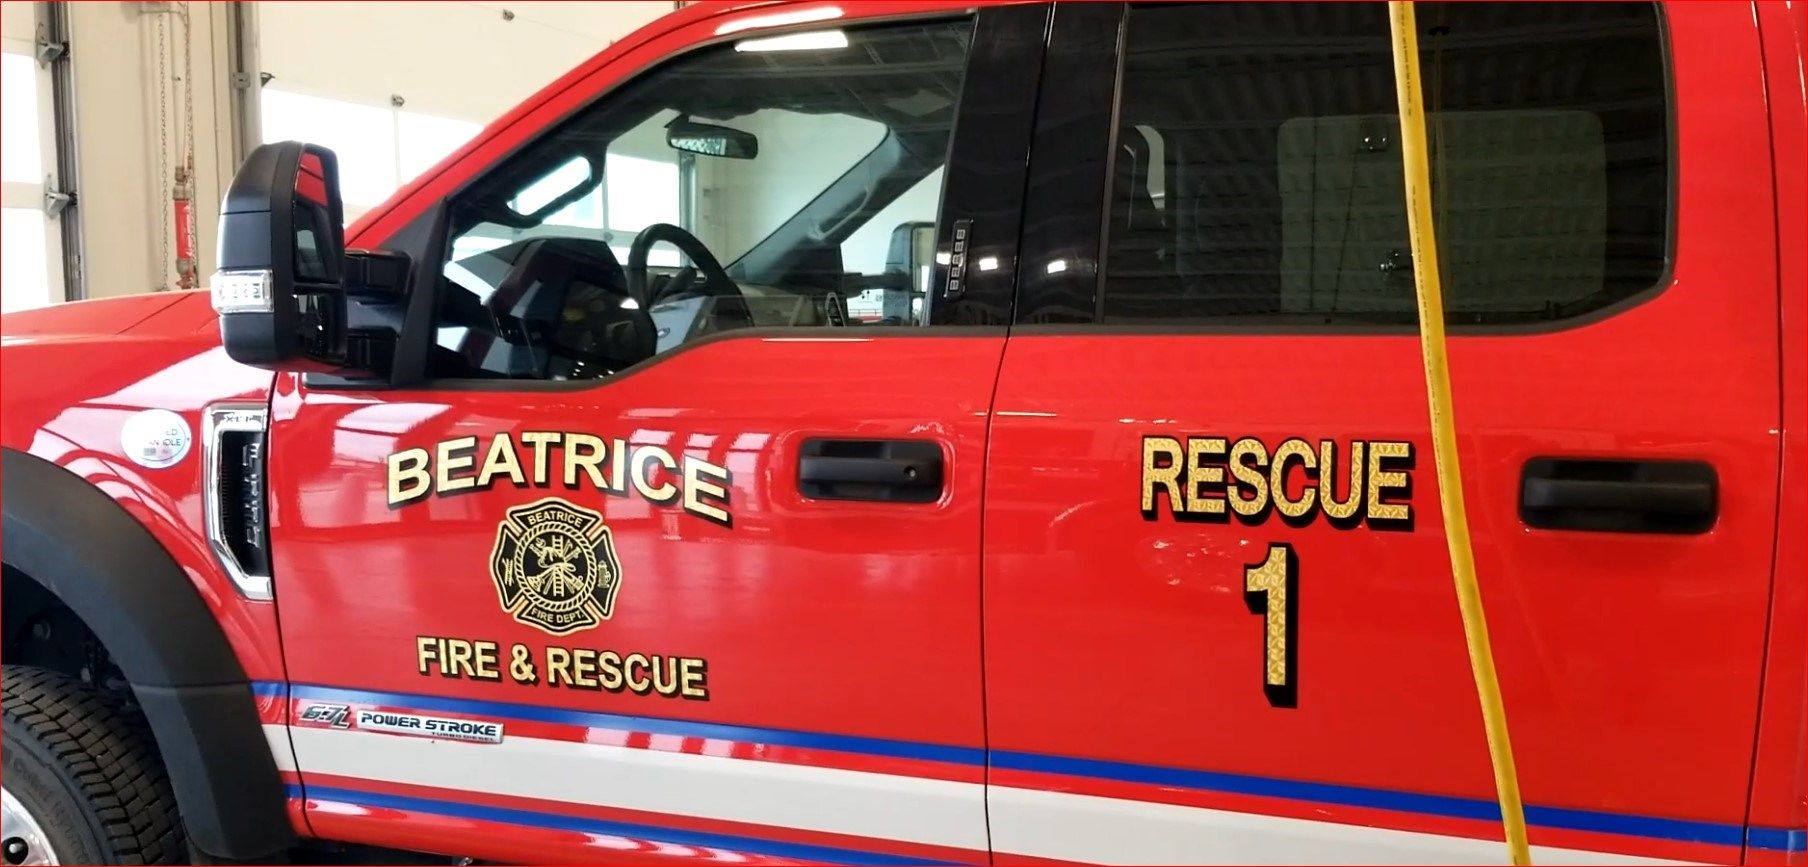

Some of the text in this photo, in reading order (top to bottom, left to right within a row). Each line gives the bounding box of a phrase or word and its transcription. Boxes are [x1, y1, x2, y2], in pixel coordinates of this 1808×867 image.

[387, 432, 731, 526] BEATRICE
[1141, 436, 1413, 527] RESCUE
[527, 510, 583, 528] BEATRICE
[530, 608, 585, 623] FIRE DEPT.
[1244, 543, 1294, 702] 1
[416, 636, 708, 699] FIRE & RESCUE
[301, 703, 352, 730] 6.7L
[360, 712, 497, 737] POWER STROKE
